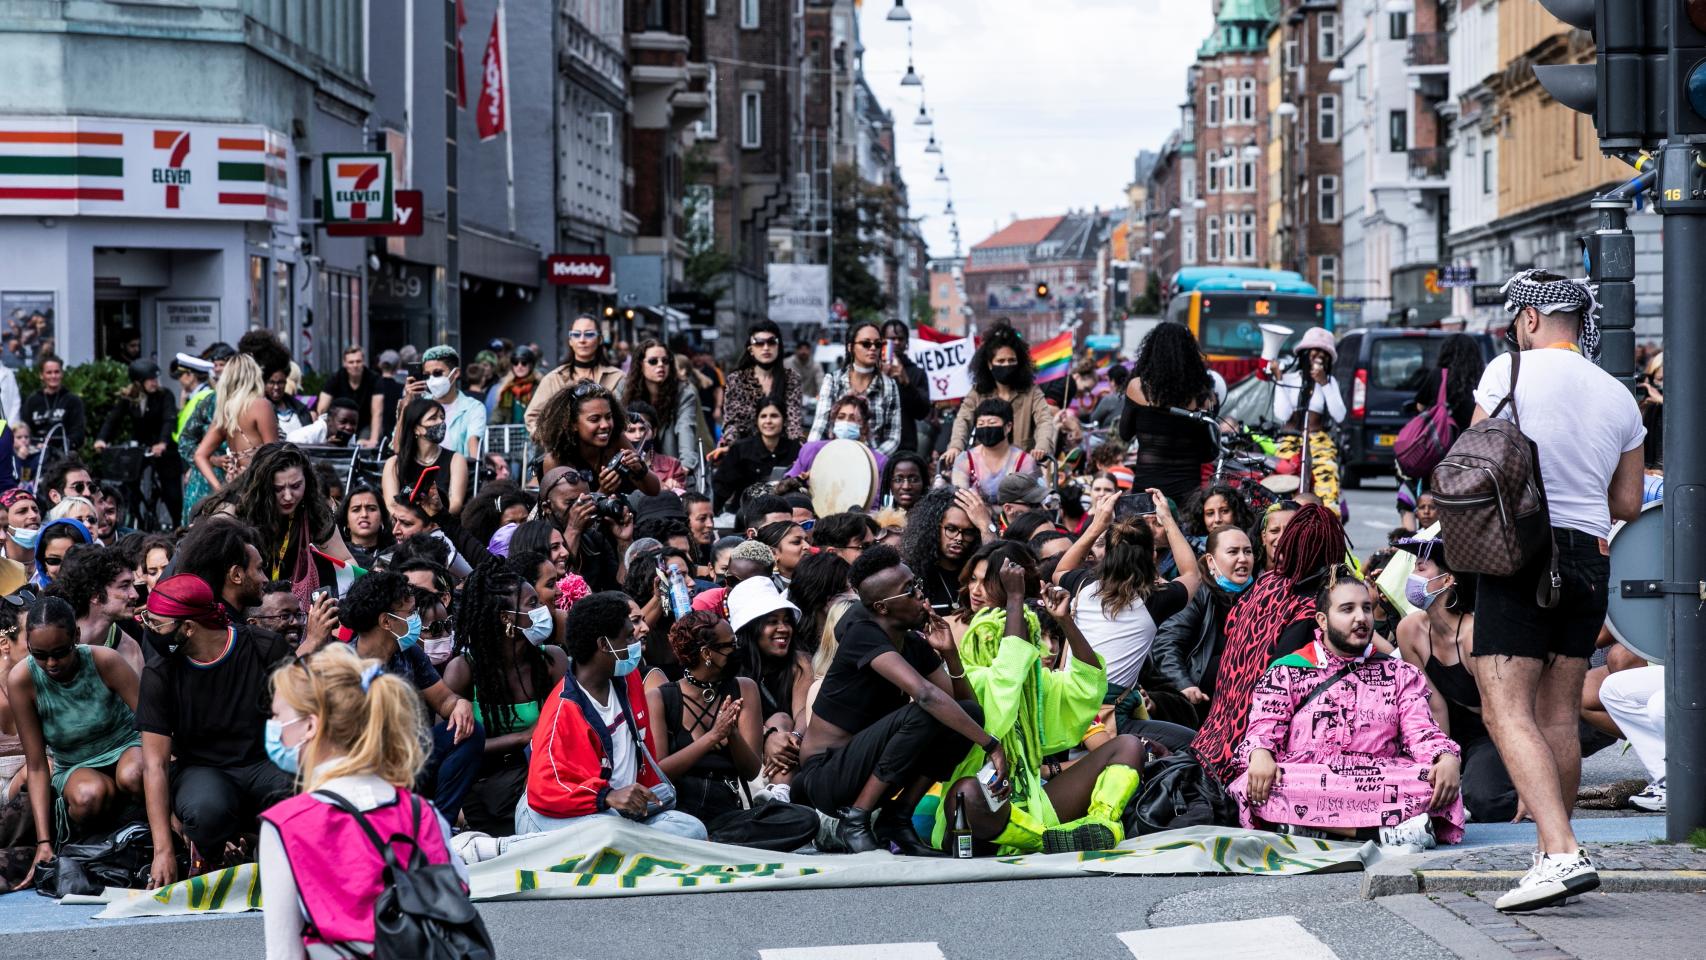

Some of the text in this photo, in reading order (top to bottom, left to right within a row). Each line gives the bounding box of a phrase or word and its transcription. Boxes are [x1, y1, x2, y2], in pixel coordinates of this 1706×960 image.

[153, 130, 190, 208] 7
[337, 163, 379, 219] 7
[1664, 189, 1681, 201] 16
[1261, 706, 1285, 716] NEWS
[1356, 784, 1381, 792] NEWS
